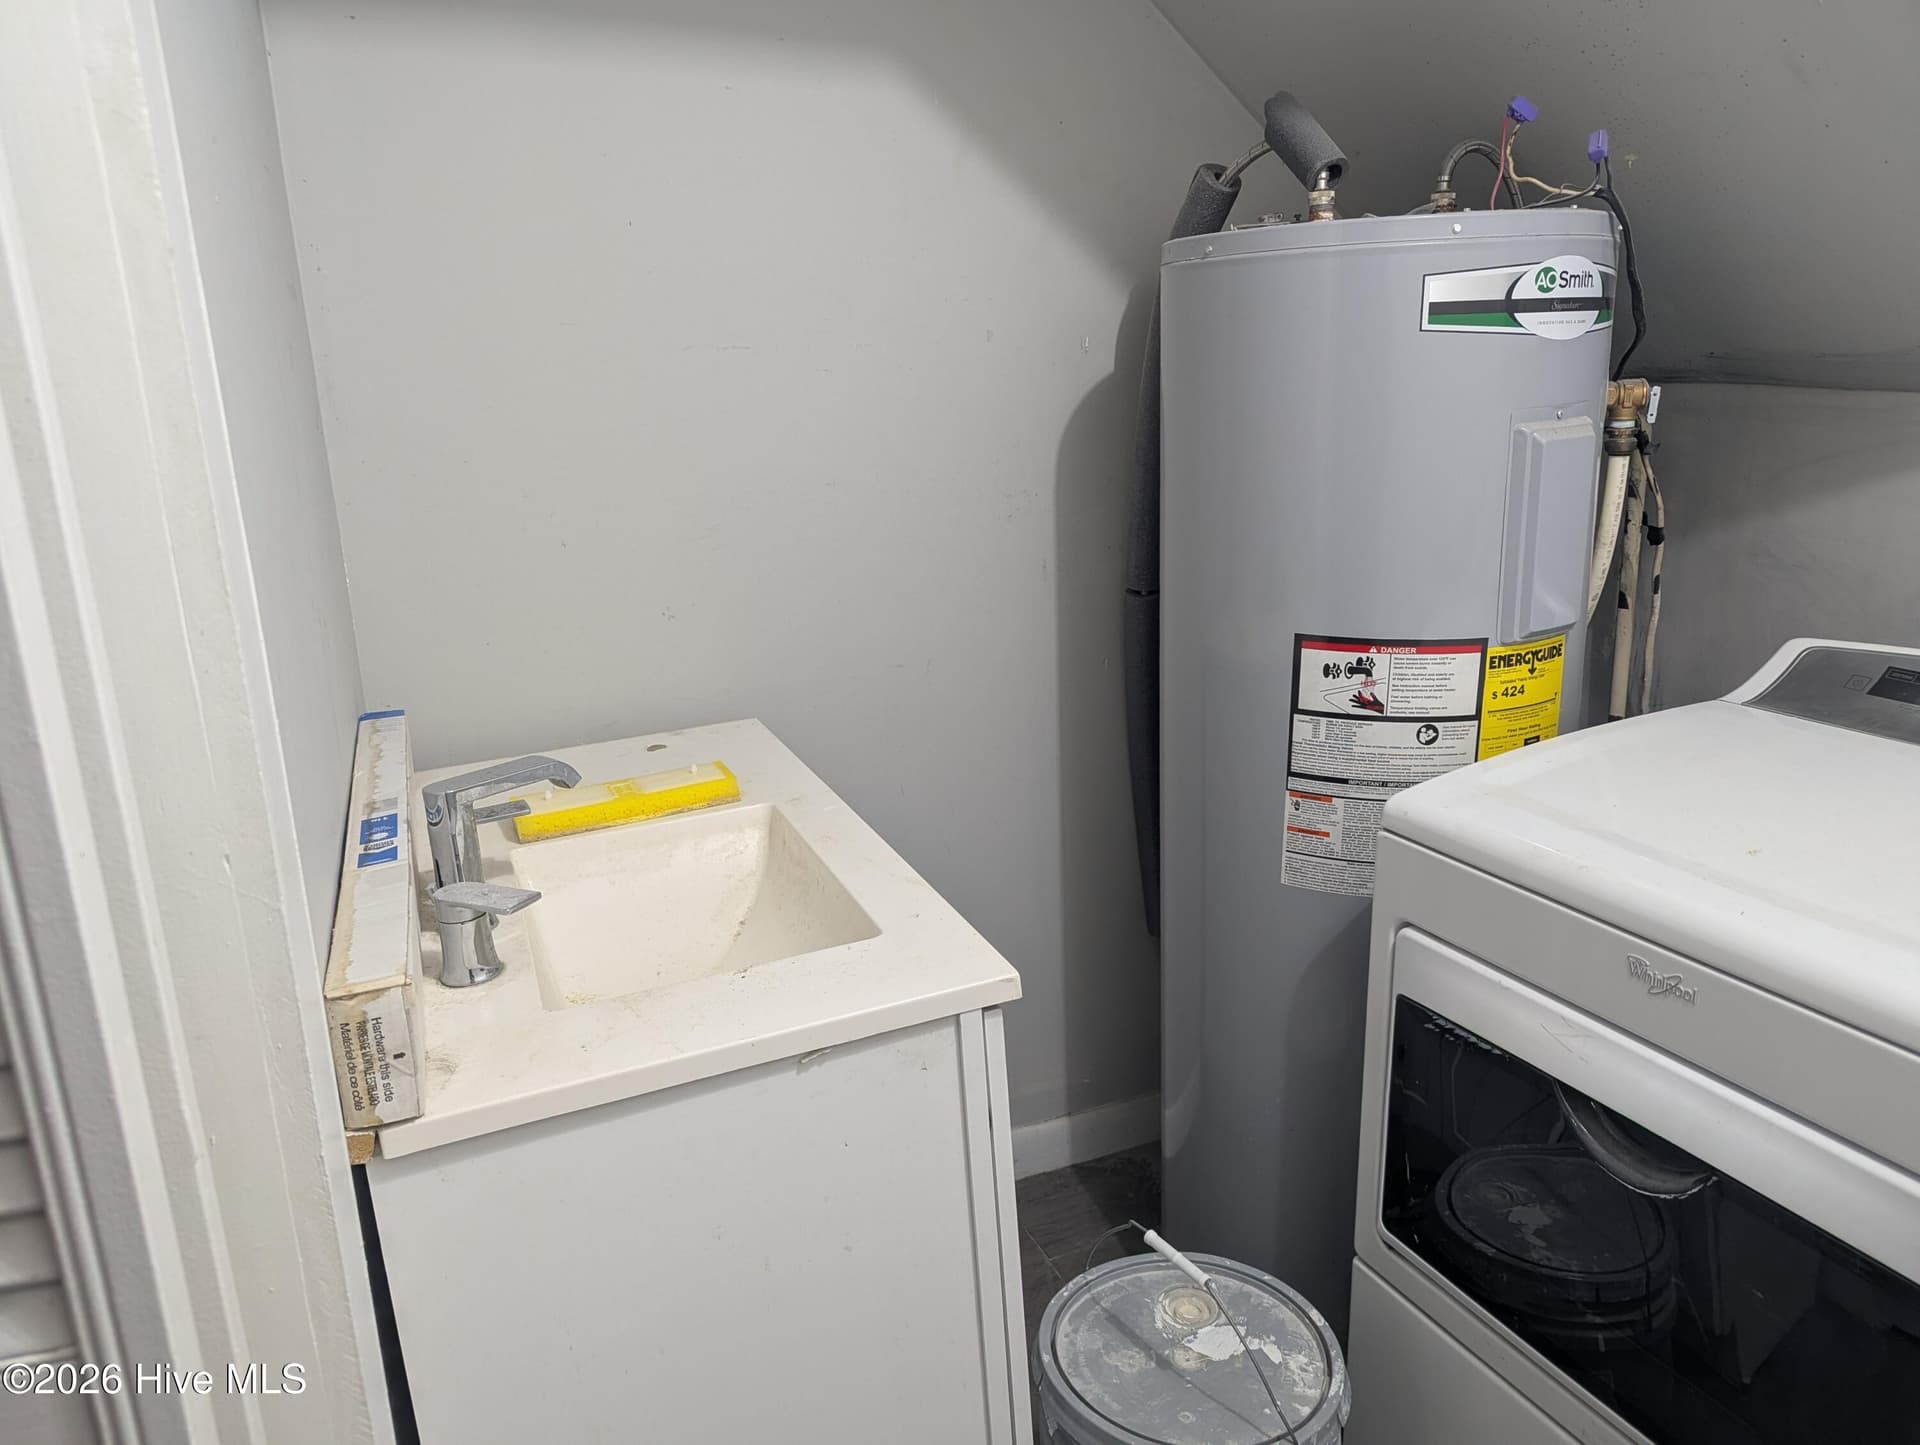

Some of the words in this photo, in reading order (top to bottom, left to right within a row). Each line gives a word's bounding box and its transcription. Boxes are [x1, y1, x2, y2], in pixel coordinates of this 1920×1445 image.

[1558, 270, 1594, 290] Smith
[1489, 643, 1563, 671] ENERGYGUIDE
[1491, 690, 1498, 700] $
[1501, 684, 1525, 698] 424
[1347, 779, 1383, 787] IMPORTANT
[1627, 953, 1698, 1005] Whirlpool
[340, 1022, 356, 1061] Matériel
[371, 1017, 386, 1062] Hardware
[346, 1061, 358, 1076] de
[380, 1062, 391, 1081] this
[349, 1075, 360, 1089] ce
[382, 1081, 395, 1103] side
[351, 1089, 366, 1111] côté
